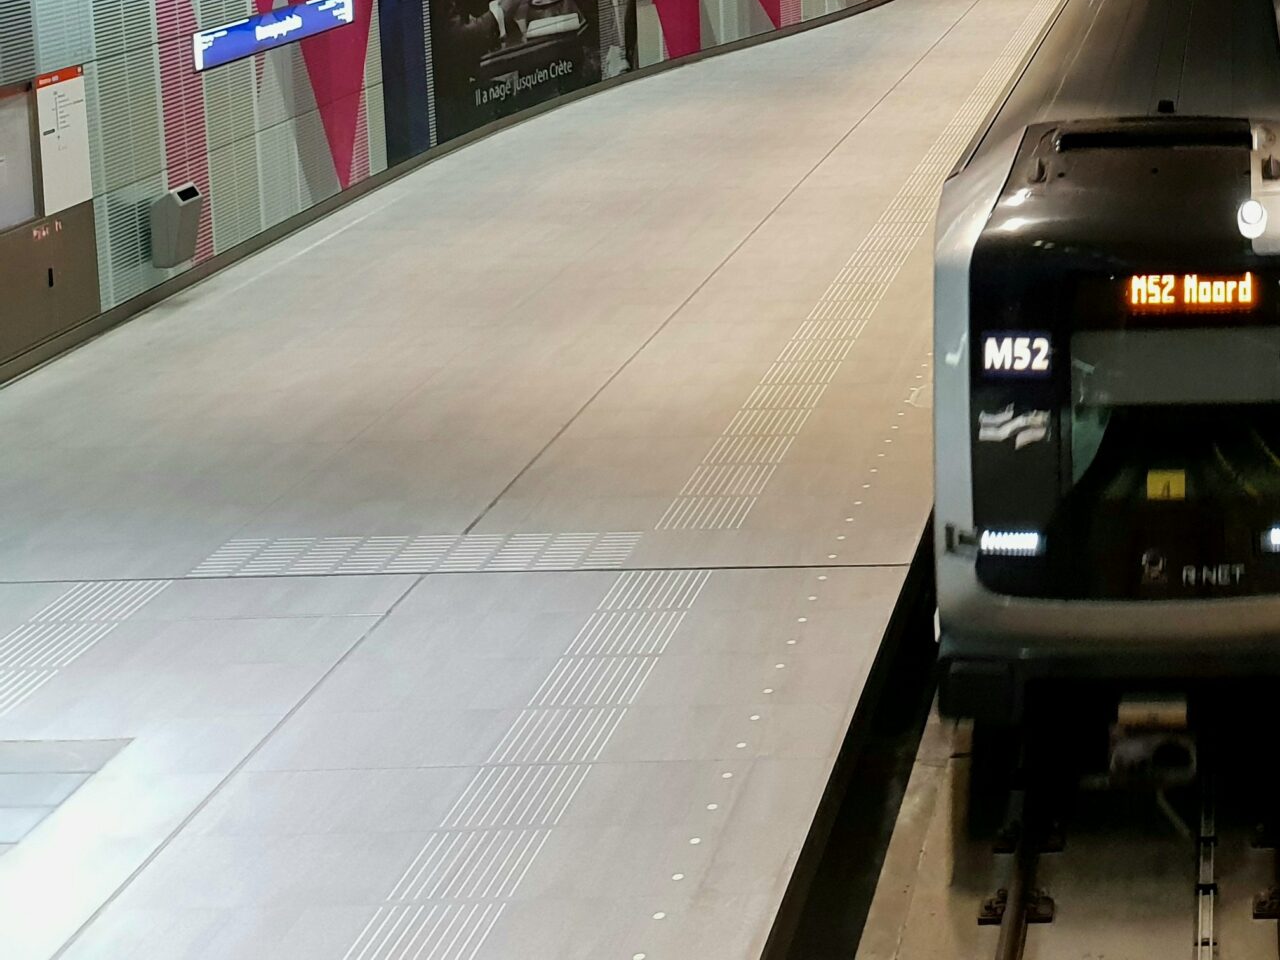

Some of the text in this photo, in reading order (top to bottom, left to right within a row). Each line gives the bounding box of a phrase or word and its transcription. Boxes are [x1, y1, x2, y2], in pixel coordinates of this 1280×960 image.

[482, 92, 488, 103] a
[1131, 271, 1252, 304] M52 Noord
[984, 336, 1050, 371] M52
